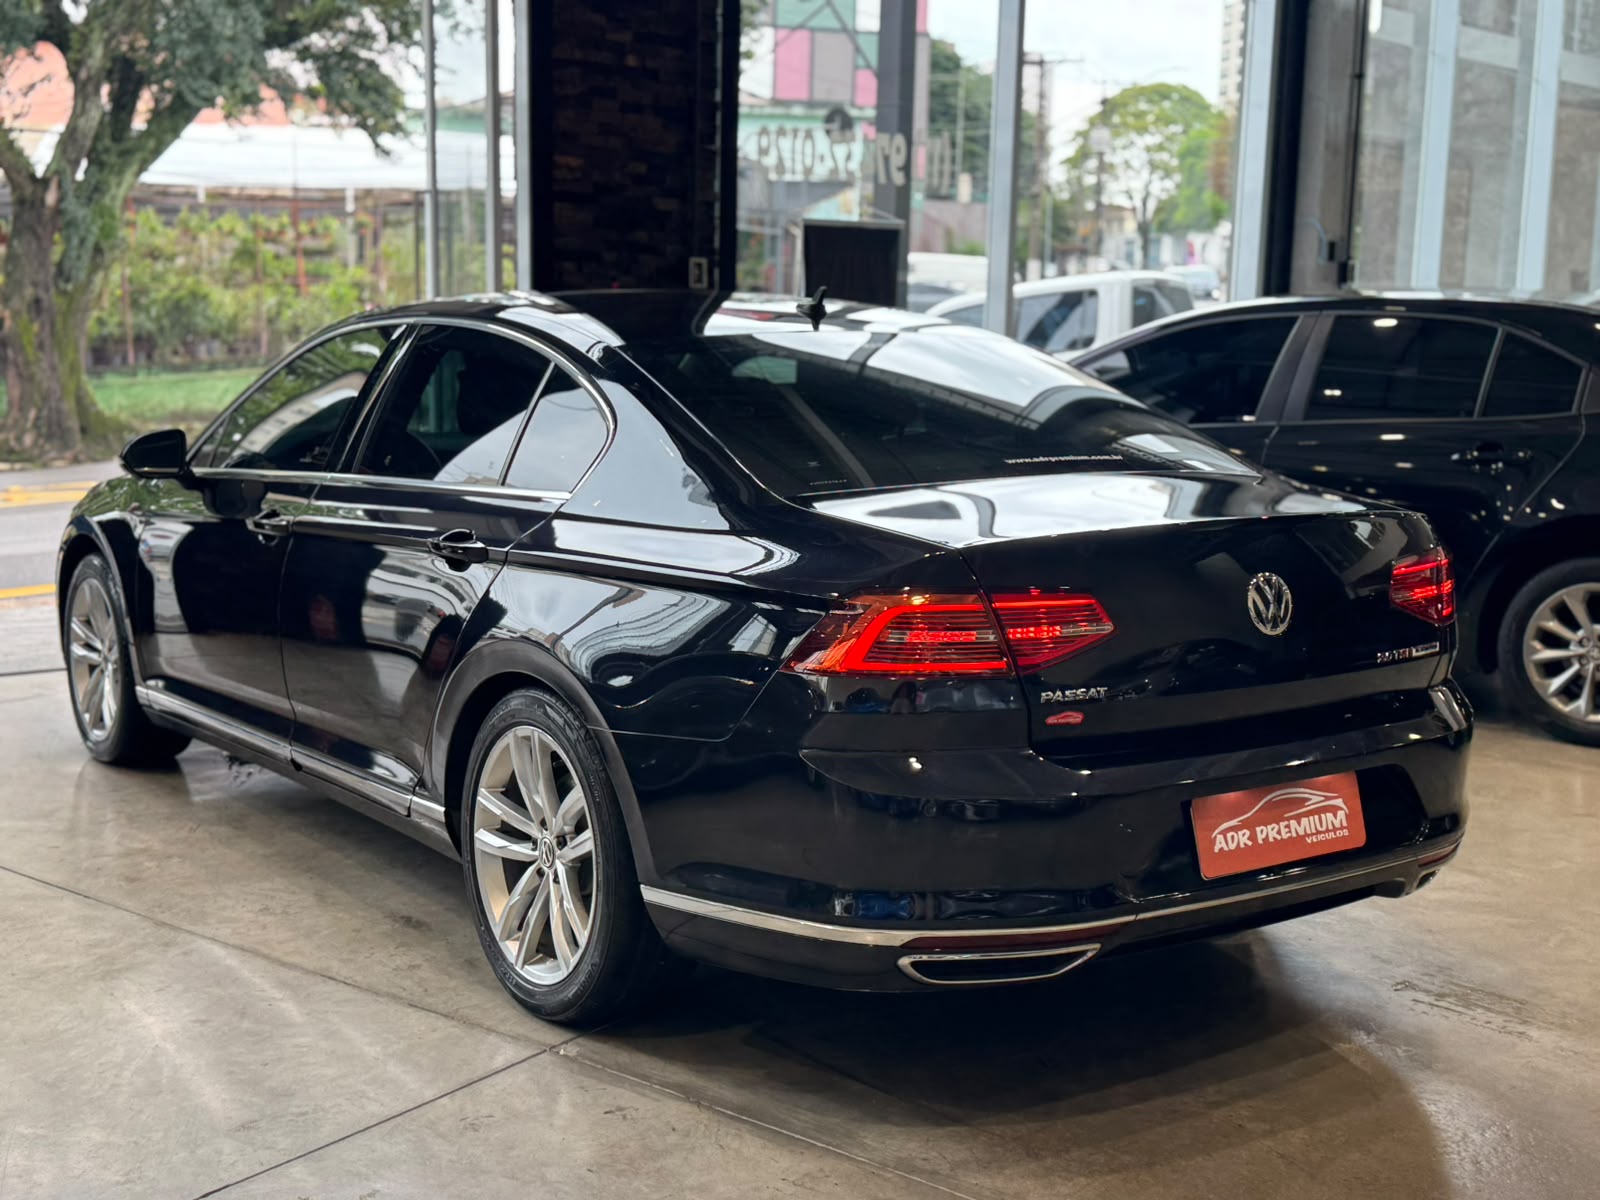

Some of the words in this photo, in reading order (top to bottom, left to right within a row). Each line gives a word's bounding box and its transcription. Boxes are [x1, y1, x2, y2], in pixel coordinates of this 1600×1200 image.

[1040, 686, 1108, 704] PASSAT
[1214, 829, 1252, 853] ADR
[1256, 810, 1347, 844] PREMIUM
